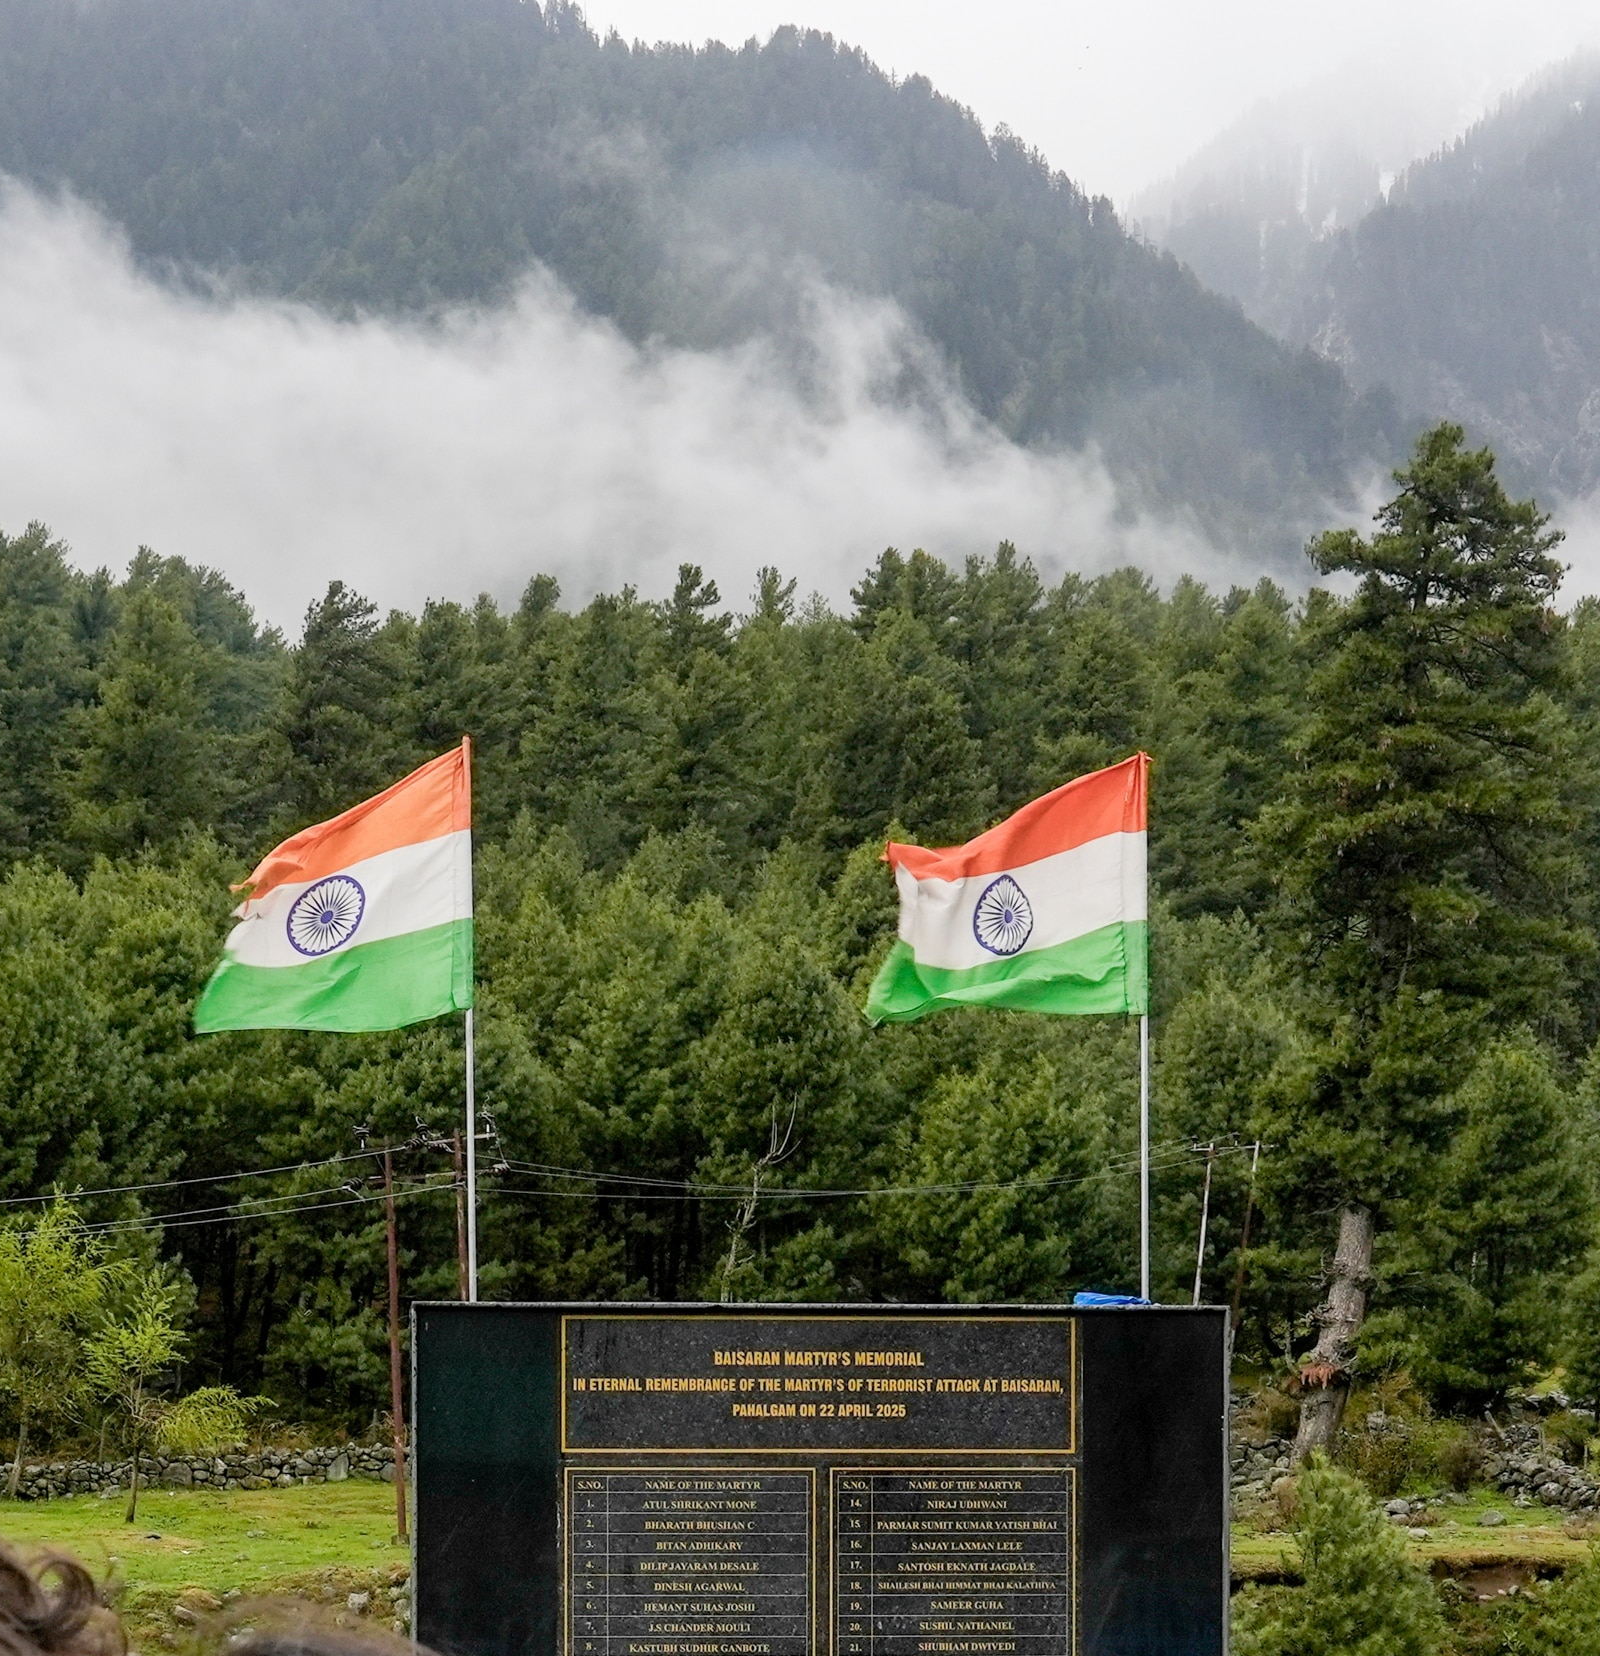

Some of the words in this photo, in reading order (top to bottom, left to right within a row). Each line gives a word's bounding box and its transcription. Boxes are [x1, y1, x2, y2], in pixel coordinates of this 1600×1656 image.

[714, 1352, 780, 1366] BAISARAN
[855, 1352, 924, 1366] MEMORIAL
[573, 1379, 585, 1391] IN
[590, 1379, 642, 1391] ETERNAL
[646, 1379, 736, 1391] REMEMBRANCE
[740, 1379, 755, 1391] OF
[758, 1379, 780, 1391] THE
[848, 1379, 863, 1392] OF
[866, 1379, 933, 1392] TERRORIST
[936, 1379, 980, 1392] ATTACK
[983, 1379, 998, 1392] AT
[1002, 1380, 1064, 1394] BAISARAN,
[733, 1404, 796, 1417] PAHALGAM
[800, 1404, 815, 1417] ON
[820, 1404, 834, 1417] 22
[838, 1404, 873, 1417] APRIL
[877, 1404, 906, 1417] 2025
[578, 1481, 604, 1489] S.NO.
[645, 1481, 675, 1490] NAME
[677, 1481, 692, 1490] OF
[694, 1481, 713, 1490] THE
[716, 1481, 761, 1490] MARTYR
[842, 1481, 868, 1489] S.NO.
[909, 1481, 939, 1490] NAME
[941, 1481, 954, 1490] OF
[957, 1481, 976, 1490] THE
[978, 1481, 1022, 1490] MARTYR
[643, 1501, 670, 1509] ATUL
[671, 1501, 724, 1509] SHRIKANT
[726, 1501, 757, 1509] MONE
[927, 1501, 957, 1509] NIRAJ
[959, 1501, 1007, 1509] UDHWANI
[586, 1520, 594, 1528] 2.
[644, 1522, 694, 1530] BHARATH
[696, 1522, 745, 1530] BHUSHAN
[747, 1522, 755, 1530] C
[877, 1521, 919, 1530] PARMAR
[921, 1521, 953, 1530] SUMIT
[955, 1521, 993, 1530] KUMAR
[994, 1521, 1031, 1530] YATISH
[1033, 1521, 1057, 1530] BHAI
[586, 1540, 594, 1548] 3.
[656, 1542, 687, 1550] BITAN
[689, 1542, 743, 1550] ADHIKARY
[850, 1540, 862, 1548] 16.
[911, 1542, 950, 1550] SANJAY
[951, 1542, 995, 1550] LAXMAN
[997, 1542, 1023, 1550] LELE
[586, 1561, 594, 1569] 4.
[640, 1562, 668, 1570] DILIP
[668, 1562, 718, 1570] JAYARAM
[720, 1562, 759, 1570] DESALE
[850, 1561, 862, 1569] 17.
[898, 1562, 944, 1571] SANTOSH
[947, 1562, 988, 1571] EKNATH
[989, 1562, 1036, 1571] JAGDALE
[586, 1581, 594, 1589] 5.
[654, 1583, 692, 1591] DINESH
[694, 1583, 745, 1591] AGARWAL
[850, 1582, 862, 1590] 18.
[878, 1582, 921, 1590] SHAILESH
[923, 1582, 944, 1590] BHAI
[946, 1582, 981, 1590] HIMMAT
[983, 1582, 1004, 1590] BHAI
[1006, 1582, 1055, 1590] KALATHIYA
[644, 1603, 689, 1612] HEMANT
[690, 1603, 724, 1612] SUHAS
[725, 1603, 755, 1612] JOSHI
[850, 1602, 862, 1610] 19.
[931, 1601, 972, 1610] SAMEER
[974, 1601, 1003, 1610] GUHA
[850, 1623, 862, 1631] 20.
[919, 1622, 955, 1630] SUSHIL
[957, 1622, 1015, 1630] NATHANIEL
[629, 1644, 677, 1653] KASTUBH
[679, 1644, 719, 1653] SUDHIR
[721, 1644, 770, 1653] GANBOTE
[918, 1643, 969, 1651] SHUBHAM
[971, 1643, 1015, 1651] DWIVEDI
